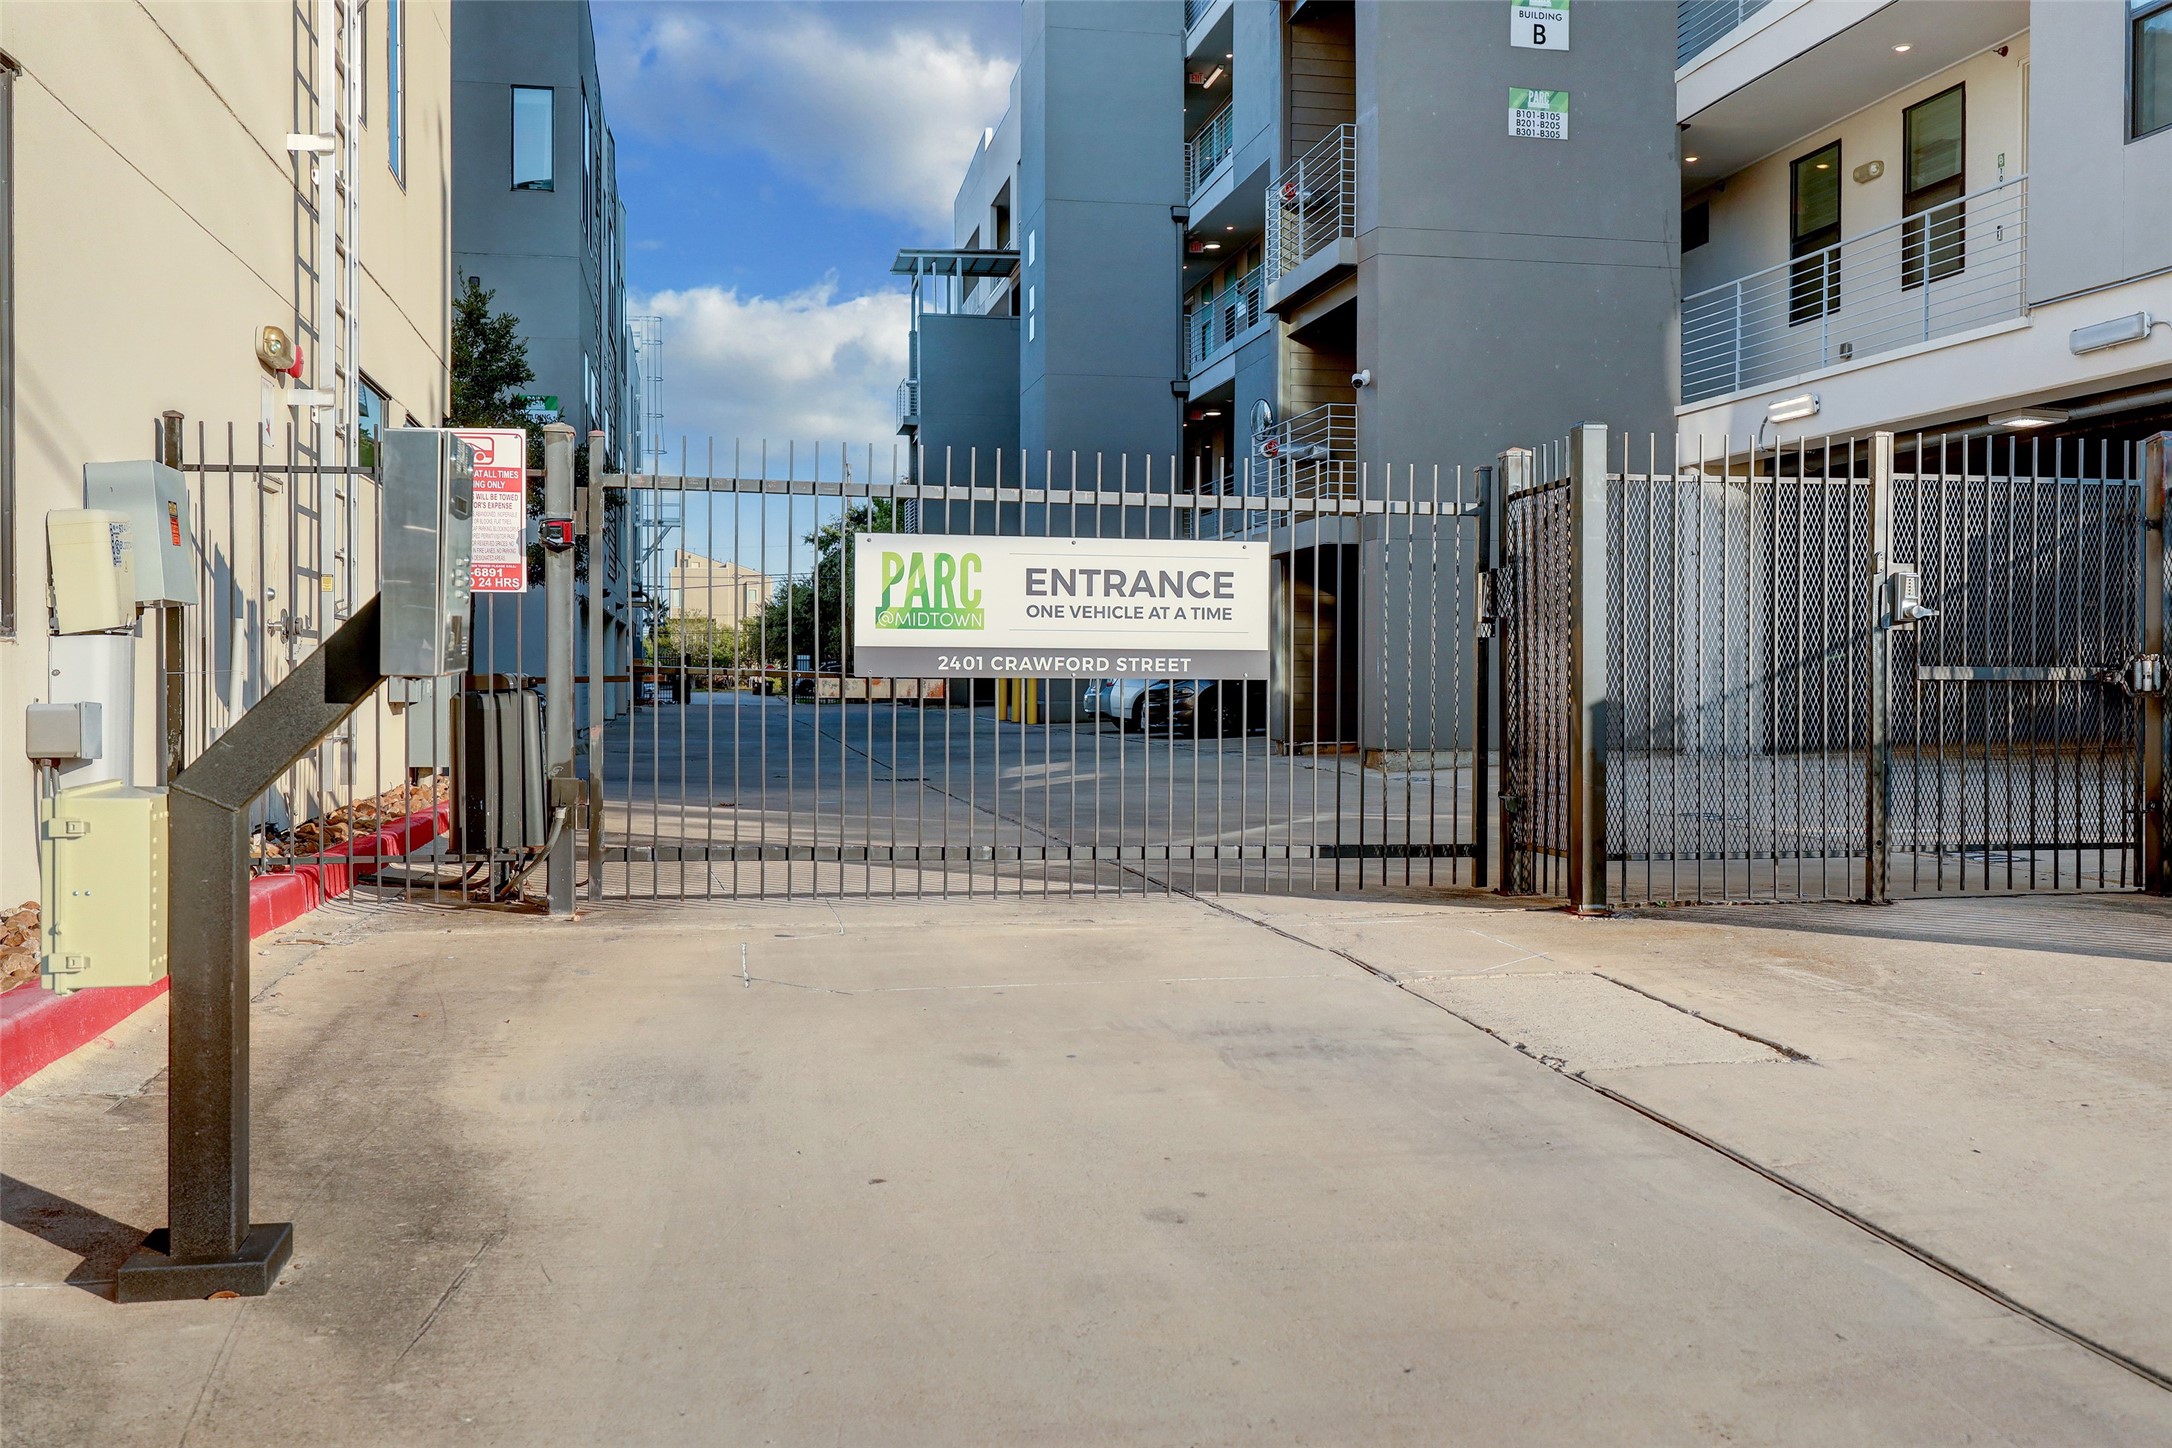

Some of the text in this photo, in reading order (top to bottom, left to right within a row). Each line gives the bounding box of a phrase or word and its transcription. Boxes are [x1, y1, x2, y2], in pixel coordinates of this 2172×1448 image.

[1519, 10, 1562, 21] BUILDING
[1533, 23, 1546, 45] B
[1528, 90, 1550, 104] PARC
[1516, 110, 1560, 121] B101-B105
[1516, 119, 1560, 130] B201-B205
[1516, 128, 1560, 138] B301-B305
[483, 470, 496, 478] ALL
[497, 470, 519, 479] TIMES
[487, 480, 506, 489] ONLY
[490, 493, 498, 501] BE
[478, 578, 492, 587] 24
[495, 578, 520, 588] HRS
[881, 551, 982, 609] PARC
[1025, 568, 1235, 599] ENTRANCE
[1026, 604, 1233, 620] ONE VEHICLE AT A TIME
[877, 610, 982, 627] @MIDTOWN
[937, 655, 1192, 673] 2401 CRAWFORD STREET
